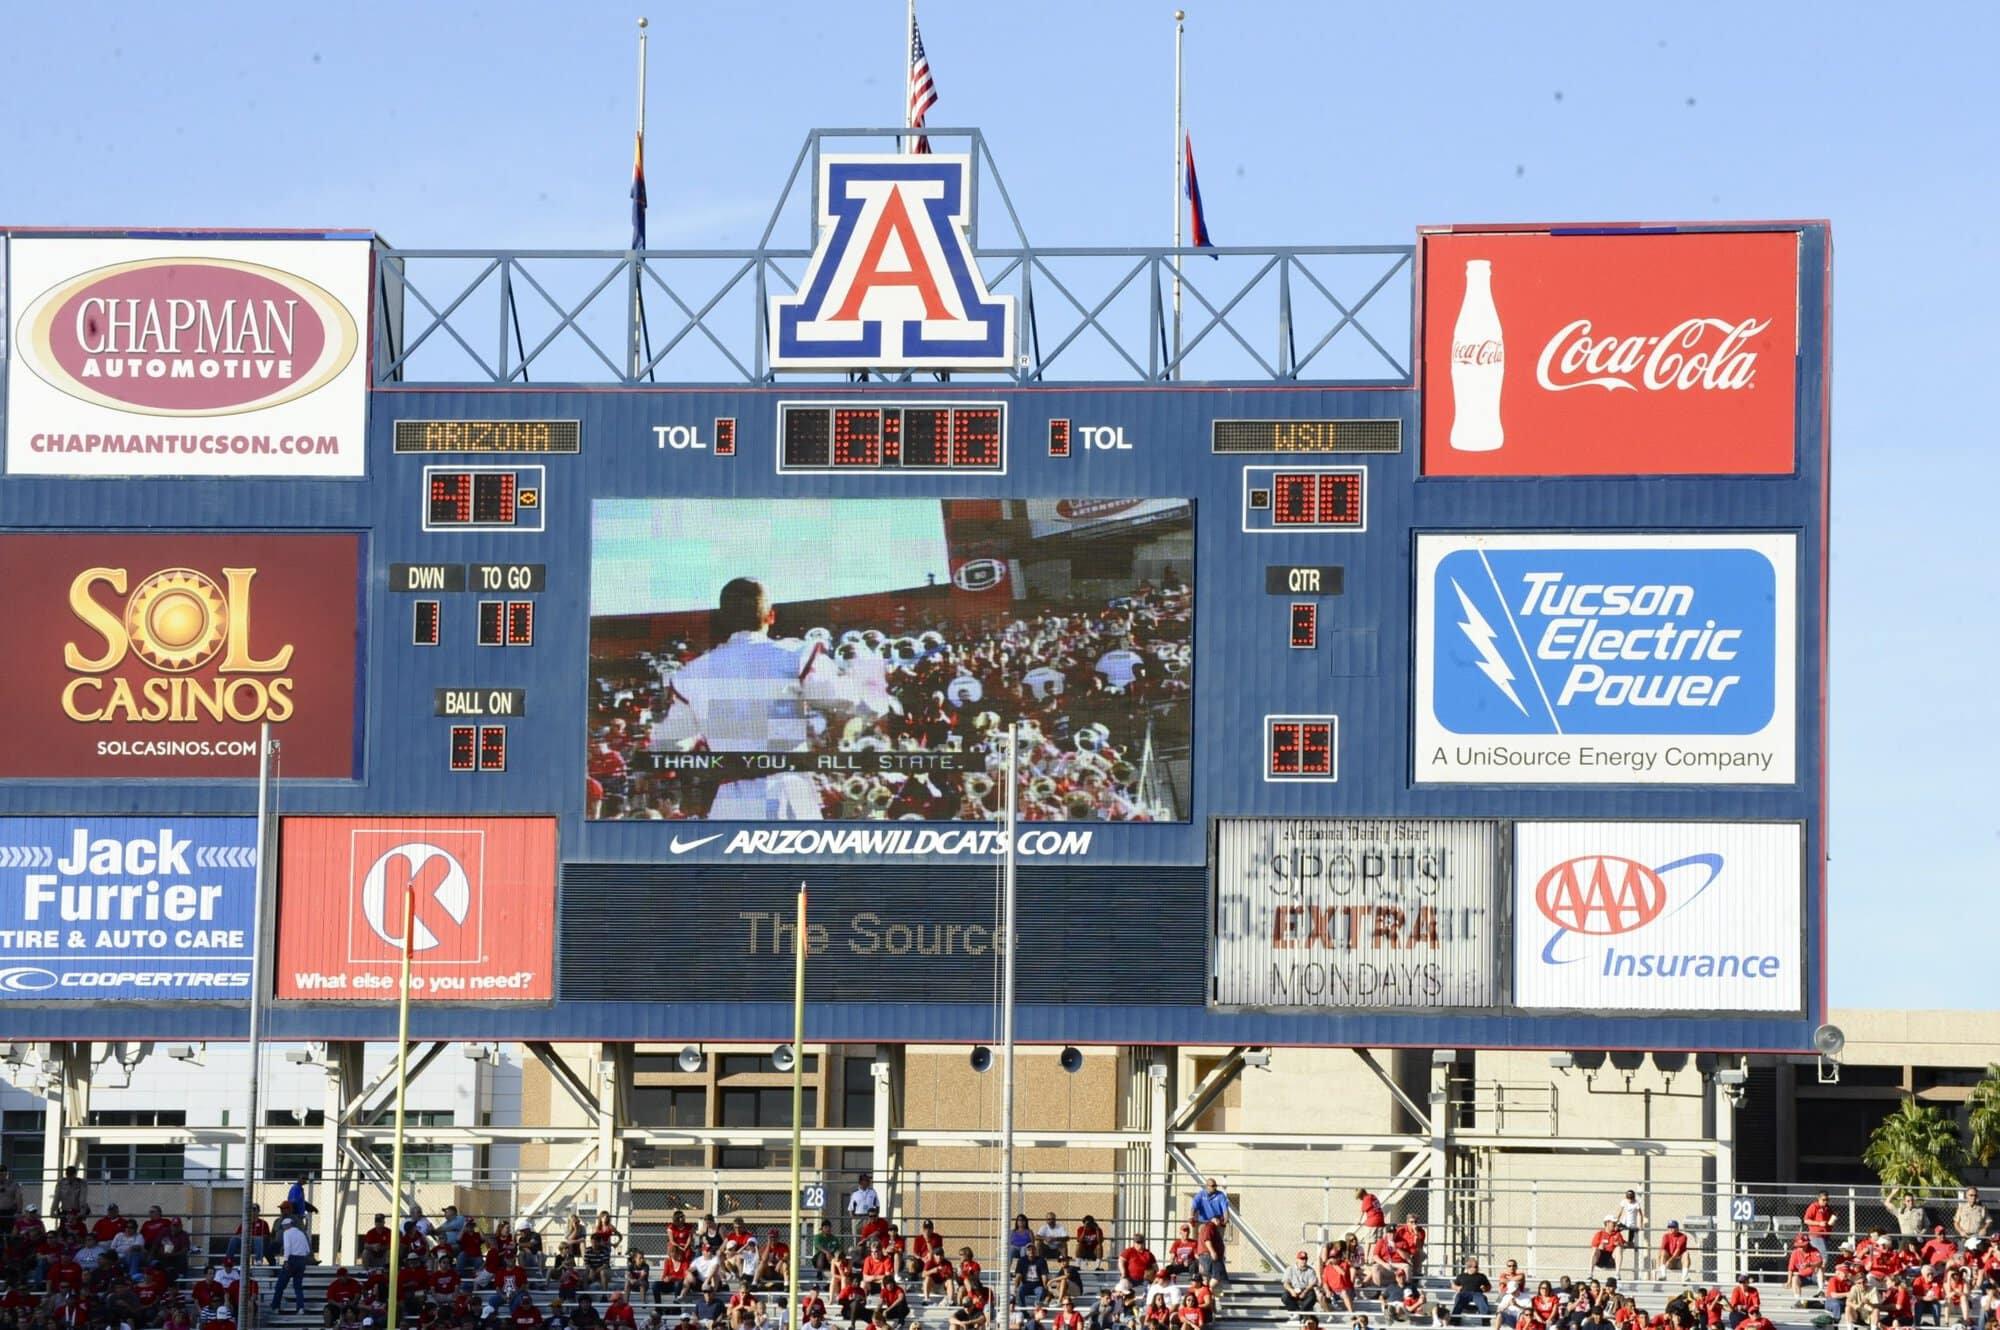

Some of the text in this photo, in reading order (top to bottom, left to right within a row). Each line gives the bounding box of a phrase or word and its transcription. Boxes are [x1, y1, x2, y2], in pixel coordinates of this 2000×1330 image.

[76, 297, 298, 356] CHAPMAN
[82, 358, 292, 379] AUTOMOTIVE
[1537, 318, 1772, 391] Coca-Cola
[30, 433, 339, 455] CHAPMANTUCSON.COM
[426, 423, 548, 451] ARIZONA
[653, 426, 706, 449] TOL
[716, 420, 734, 453] 3
[836, 410, 999, 464] 6:16
[1050, 420, 1069, 454] 3
[1079, 427, 1132, 450] TOL
[1275, 424, 1335, 451] WSU
[432, 475, 513, 520] 41
[1276, 475, 1359, 521] 00
[408, 567, 445, 589] DWN
[481, 567, 531, 589] TO GO
[1288, 568, 1320, 592] QTR
[1519, 572, 1694, 616] Tucson
[64, 567, 294, 673] SOL
[495, 604, 531, 642] 10
[1293, 606, 1314, 643] 3
[1536, 619, 1743, 661] Electric
[61, 677, 294, 723] CASINOS
[1556, 663, 1741, 707] Power
[445, 692, 512, 714] BALL ON
[97, 741, 257, 757] SOLCASINOS.COM
[453, 729, 503, 767] 35
[650, 755, 964, 772] THANK YOU, ALL STATE.
[1274, 725, 1329, 771] 25
[1432, 747, 1774, 771] A UniSource Energy Company
[57, 828, 193, 876] Jack
[724, 830, 1093, 856] ARIZONAWILDCATSCOM
[1269, 854, 1441, 896] SPORTS
[24, 874, 222, 921] Furrier
[1546, 856, 1656, 935] AAA
[0, 930, 245, 949] TIRE & AUTO CARE
[739, 911, 1019, 955] The Source
[1272, 905, 1441, 950] EXTRA
[60, 972, 250, 987] COOPERTIRES
[1272, 962, 1443, 997] MONDAYS
[1602, 947, 1781, 978] Insurance
[295, 972, 347, 989] What
[352, 973, 393, 990] else
[430, 976, 465, 993] you
[470, 972, 532, 989] need?
[806, 1187, 825, 1207] 28
[1733, 1200, 1753, 1220] 29
